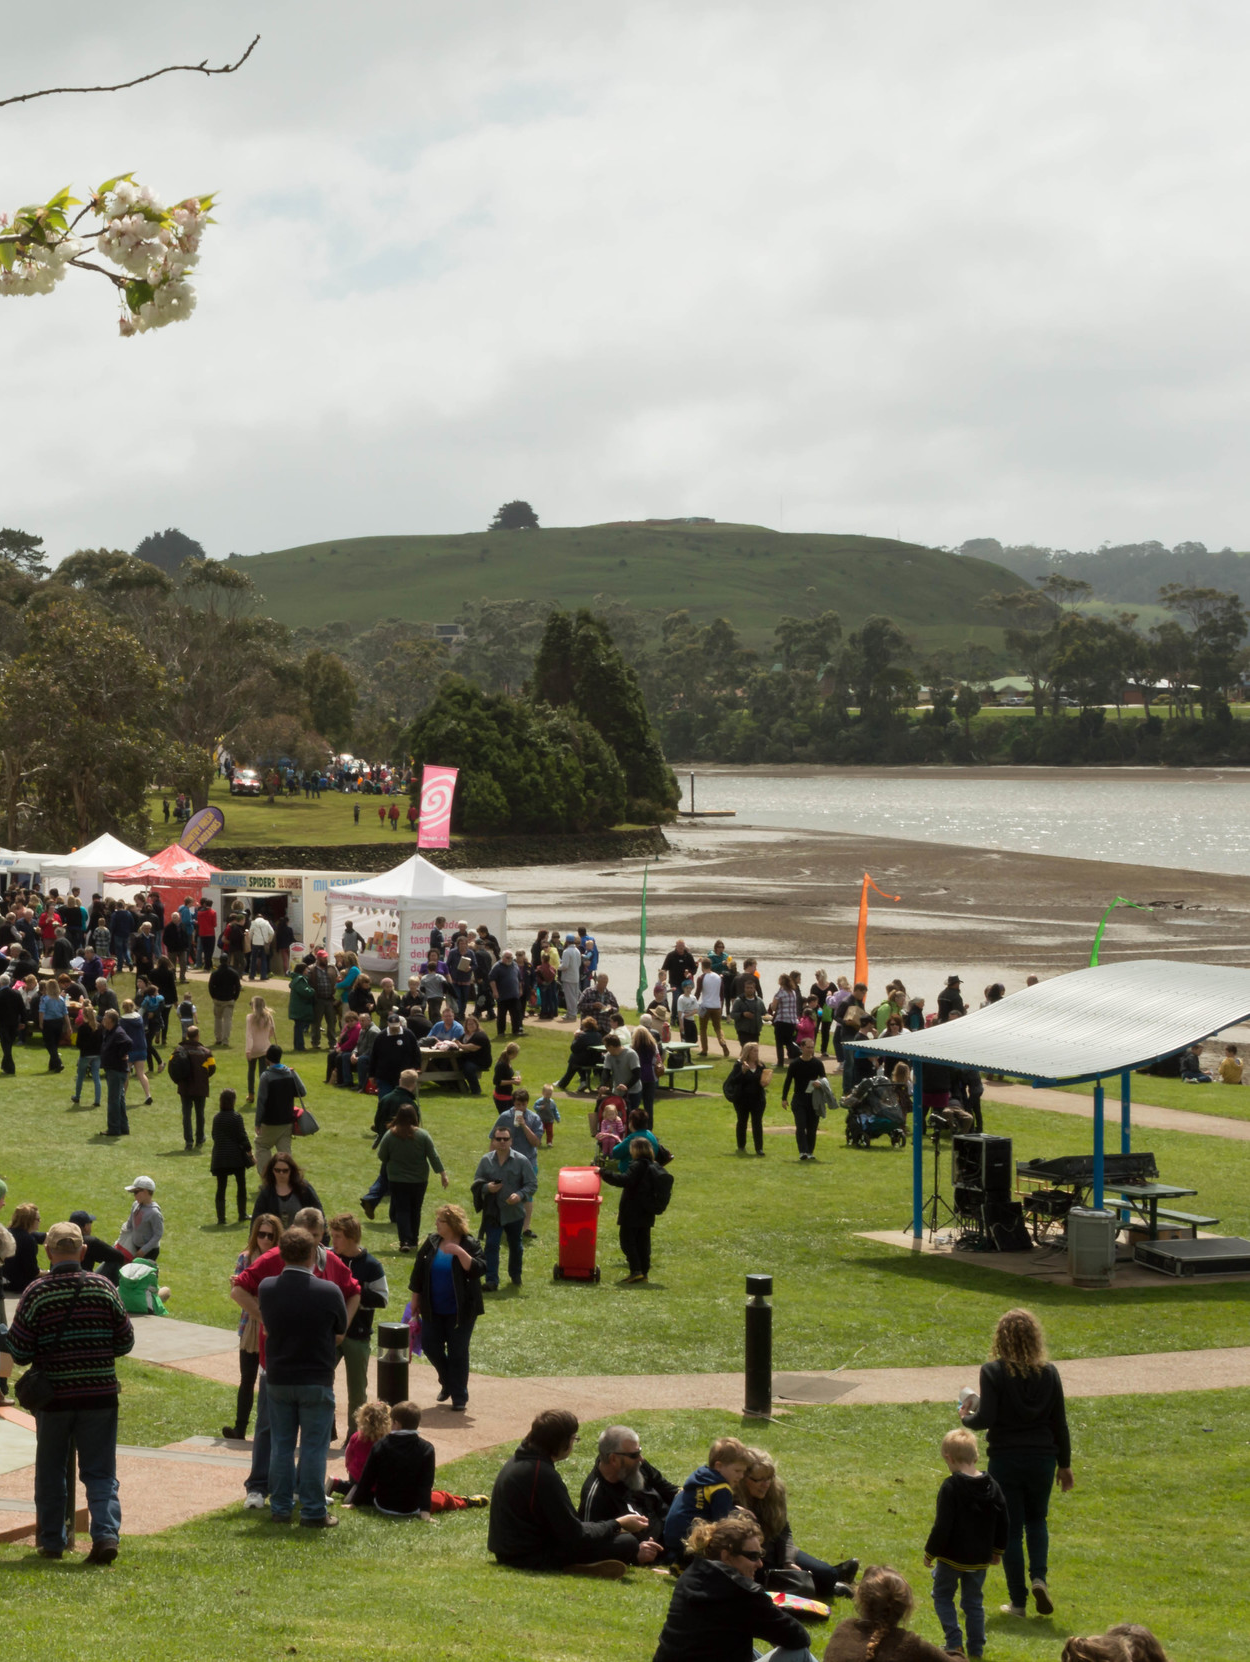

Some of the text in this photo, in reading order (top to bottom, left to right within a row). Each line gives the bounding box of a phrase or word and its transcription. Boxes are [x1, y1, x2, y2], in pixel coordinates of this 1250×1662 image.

[210, 874, 247, 887] MILKSHAKES
[249, 876, 276, 888] SPIDERS
[411, 921, 459, 930] handade
